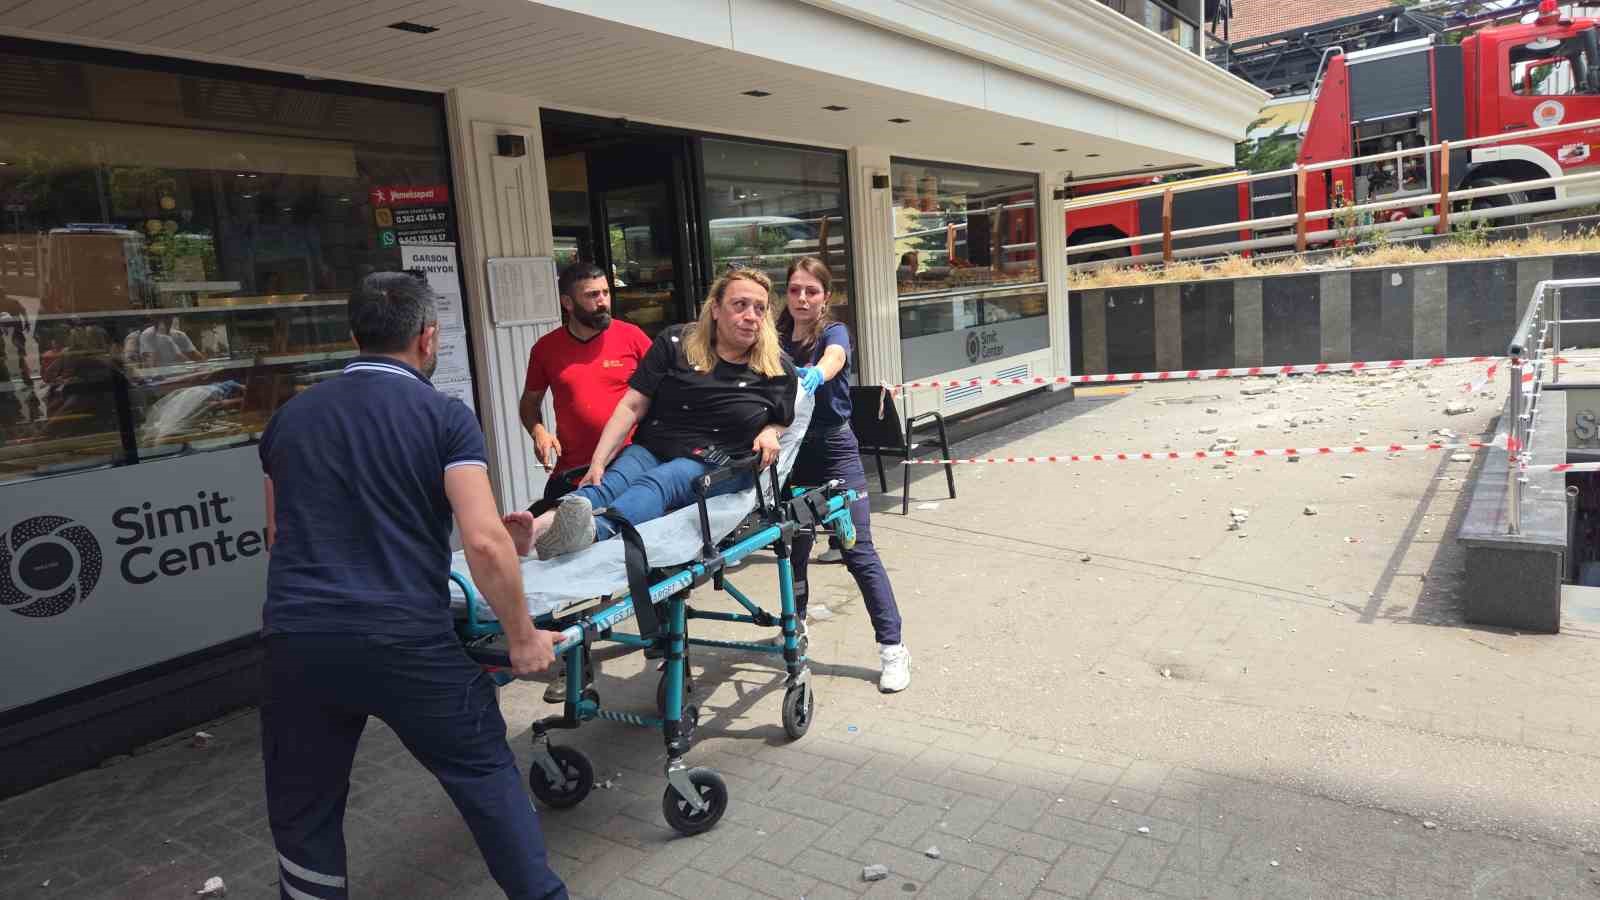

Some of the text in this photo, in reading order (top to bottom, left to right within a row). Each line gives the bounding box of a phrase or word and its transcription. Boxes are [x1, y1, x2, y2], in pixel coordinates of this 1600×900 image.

[412, 254, 449, 263] GARSON
[982, 330, 998, 345] Simit
[982, 344, 1004, 358] Center
[111, 490, 233, 545] Simit
[652, 583, 675, 601] ARGET
